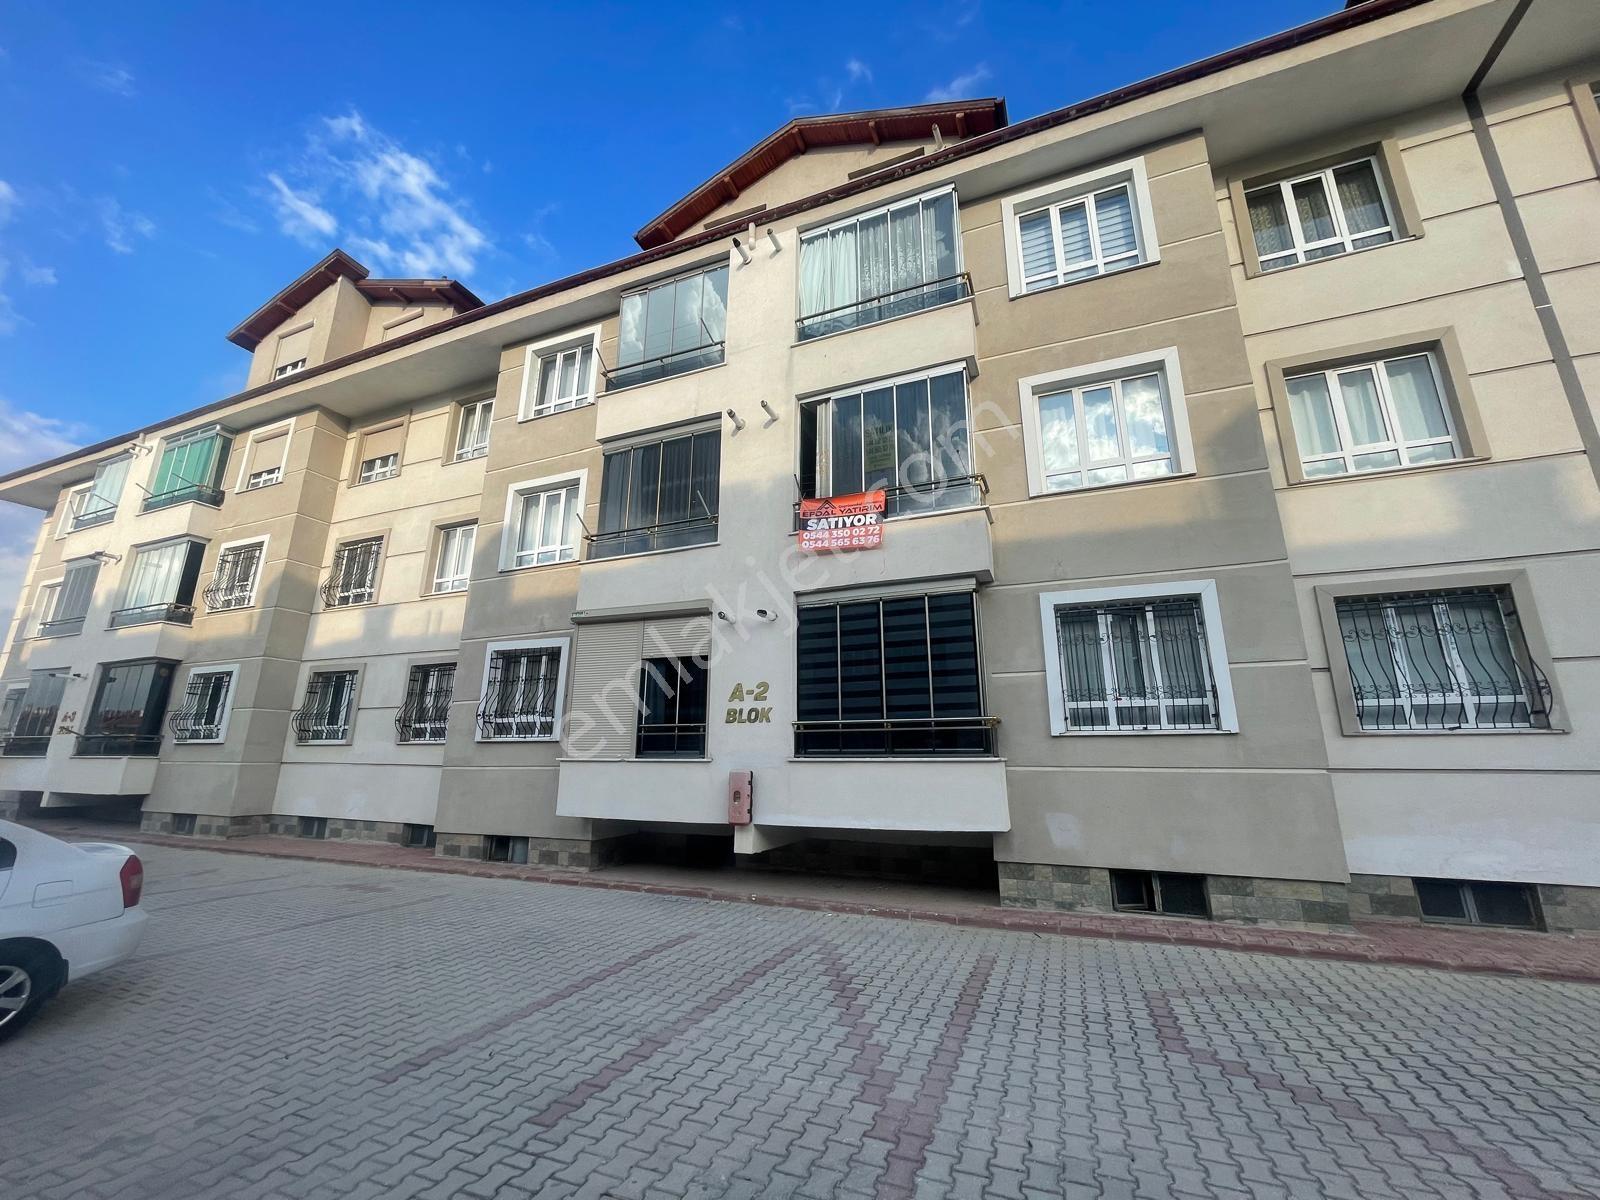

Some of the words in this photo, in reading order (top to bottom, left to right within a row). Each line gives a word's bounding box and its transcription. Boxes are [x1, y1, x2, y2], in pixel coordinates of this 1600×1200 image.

[806, 513, 877, 531] SATIYOR
[801, 539, 830, 549] 0544
[830, 538, 851, 546] 565
[852, 536, 866, 545] 63
[867, 535, 880, 544] 76
[802, 531, 830, 540] 0544
[831, 529, 851, 538] 350
[852, 528, 866, 536] 02
[867, 526, 880, 535] 72
[727, 681, 770, 703] A-2
[724, 706, 773, 724] BLOK
